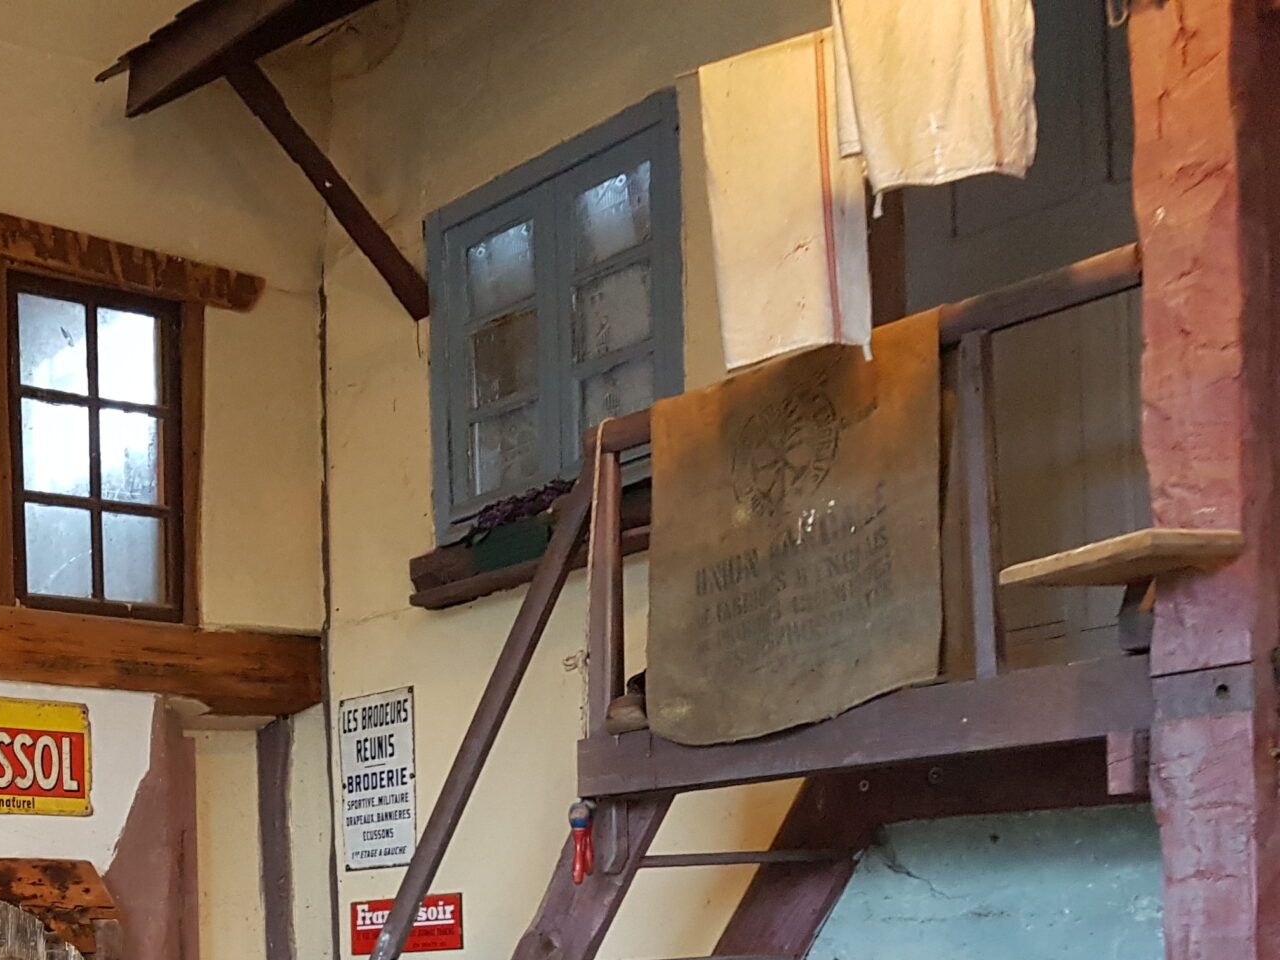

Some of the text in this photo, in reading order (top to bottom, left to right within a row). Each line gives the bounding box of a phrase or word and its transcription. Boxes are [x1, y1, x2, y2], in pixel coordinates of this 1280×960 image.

[342, 698, 408, 734] LES BRODEURS
[347, 767, 408, 794] BRODERIE
[383, 846, 407, 857] GAUCHE
